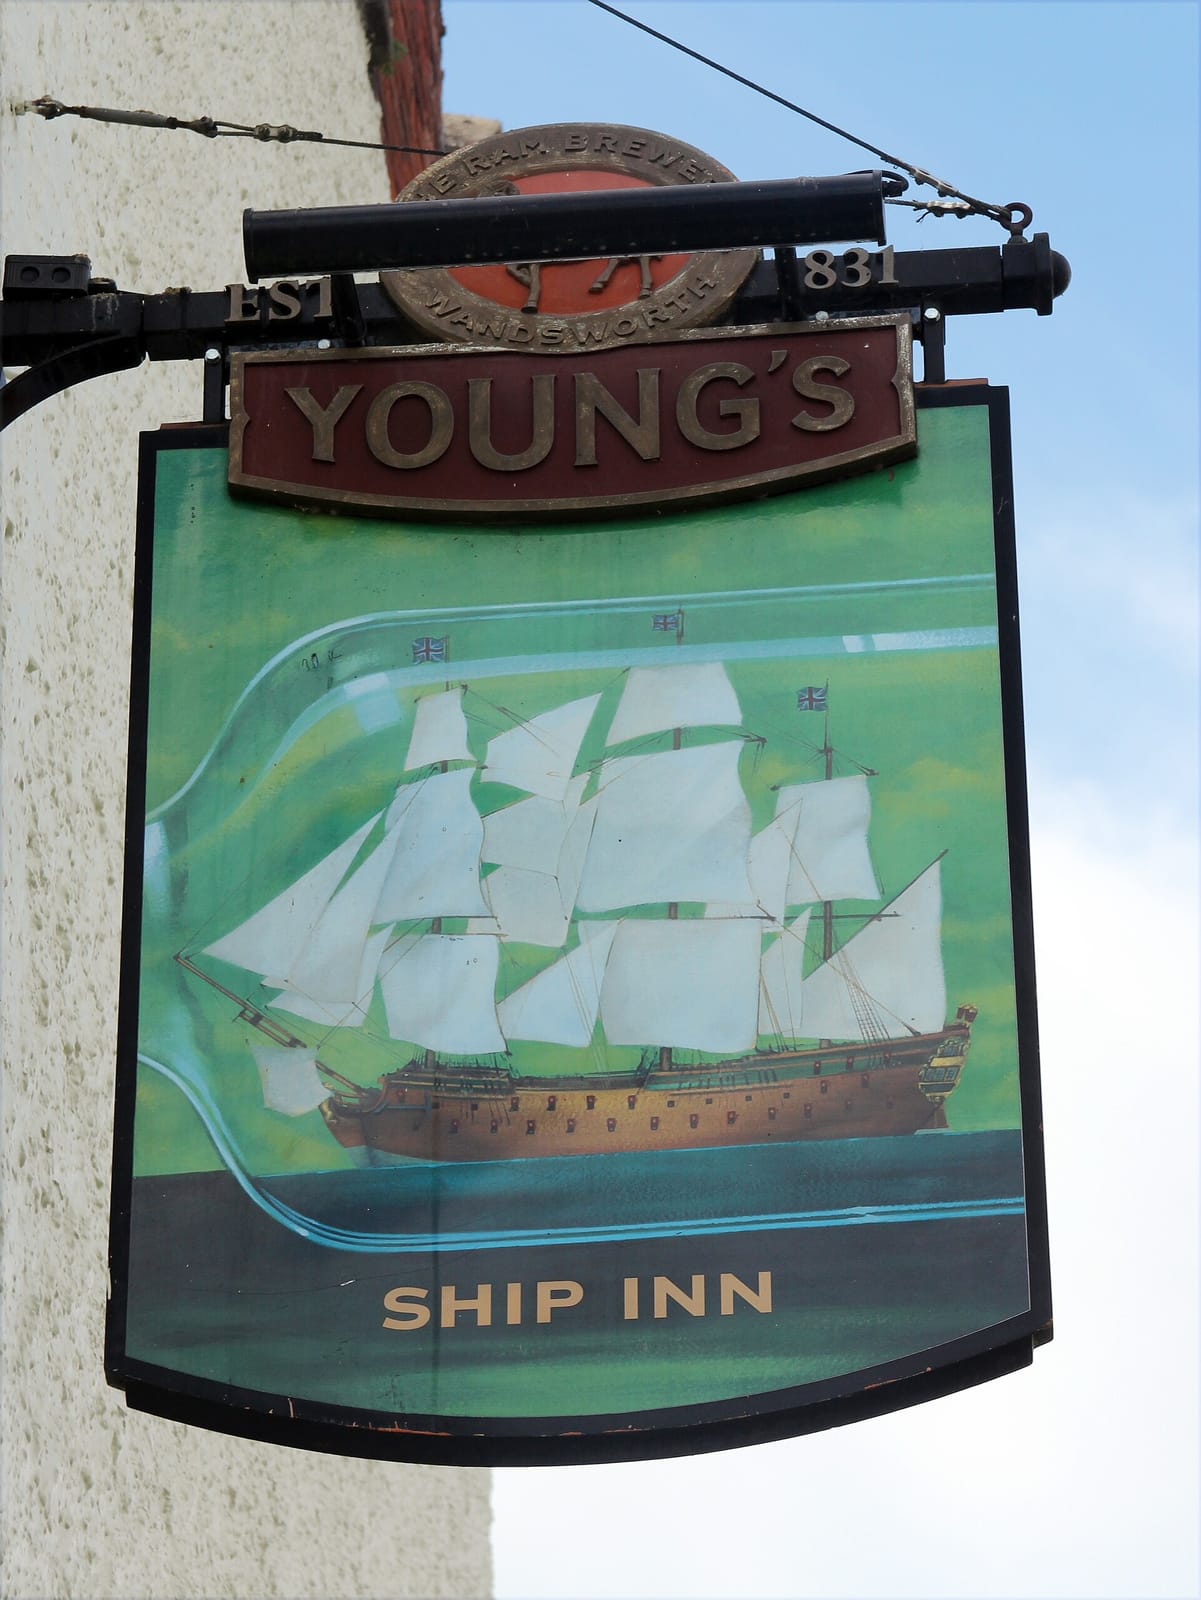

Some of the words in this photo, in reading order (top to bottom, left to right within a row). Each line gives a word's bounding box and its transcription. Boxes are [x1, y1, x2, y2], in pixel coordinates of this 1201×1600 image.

[463, 136, 547, 169] RAM
[804, 245, 899, 289] 831
[424, 276, 717, 346] WANDSWORTH
[285, 349, 855, 471] YOUNG'S
[382, 1280, 584, 1331] SHIP
[623, 1271, 773, 1320] INN
